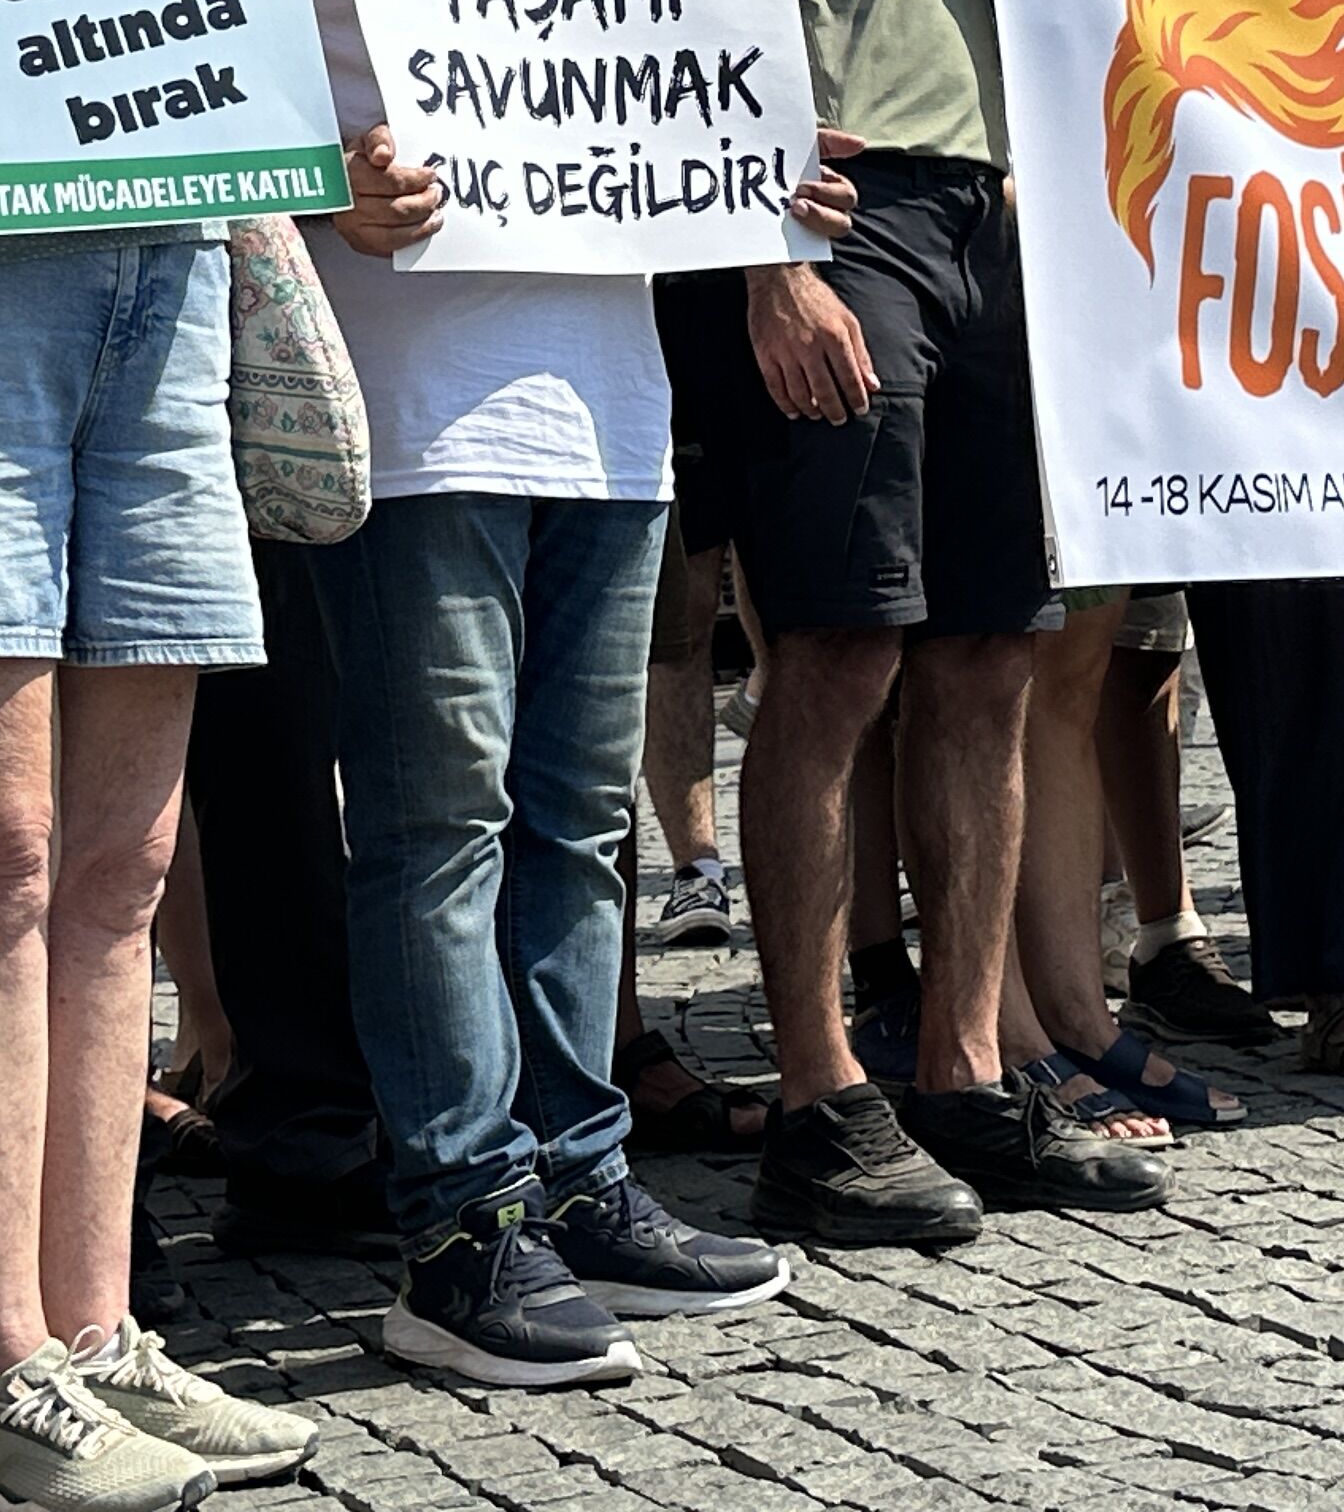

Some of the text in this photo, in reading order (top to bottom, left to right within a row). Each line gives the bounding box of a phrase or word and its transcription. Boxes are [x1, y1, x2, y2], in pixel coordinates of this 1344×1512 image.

[65, 63, 248, 146] bırak
[407, 45, 765, 129] SAVUNMAK
[55, 175, 237, 214] MÜCADELEYE
[240, 166, 326, 201] KATIL!
[522, 136, 793, 224] DEĞİLDİR!
[1199, 472, 1315, 515] KASIM
